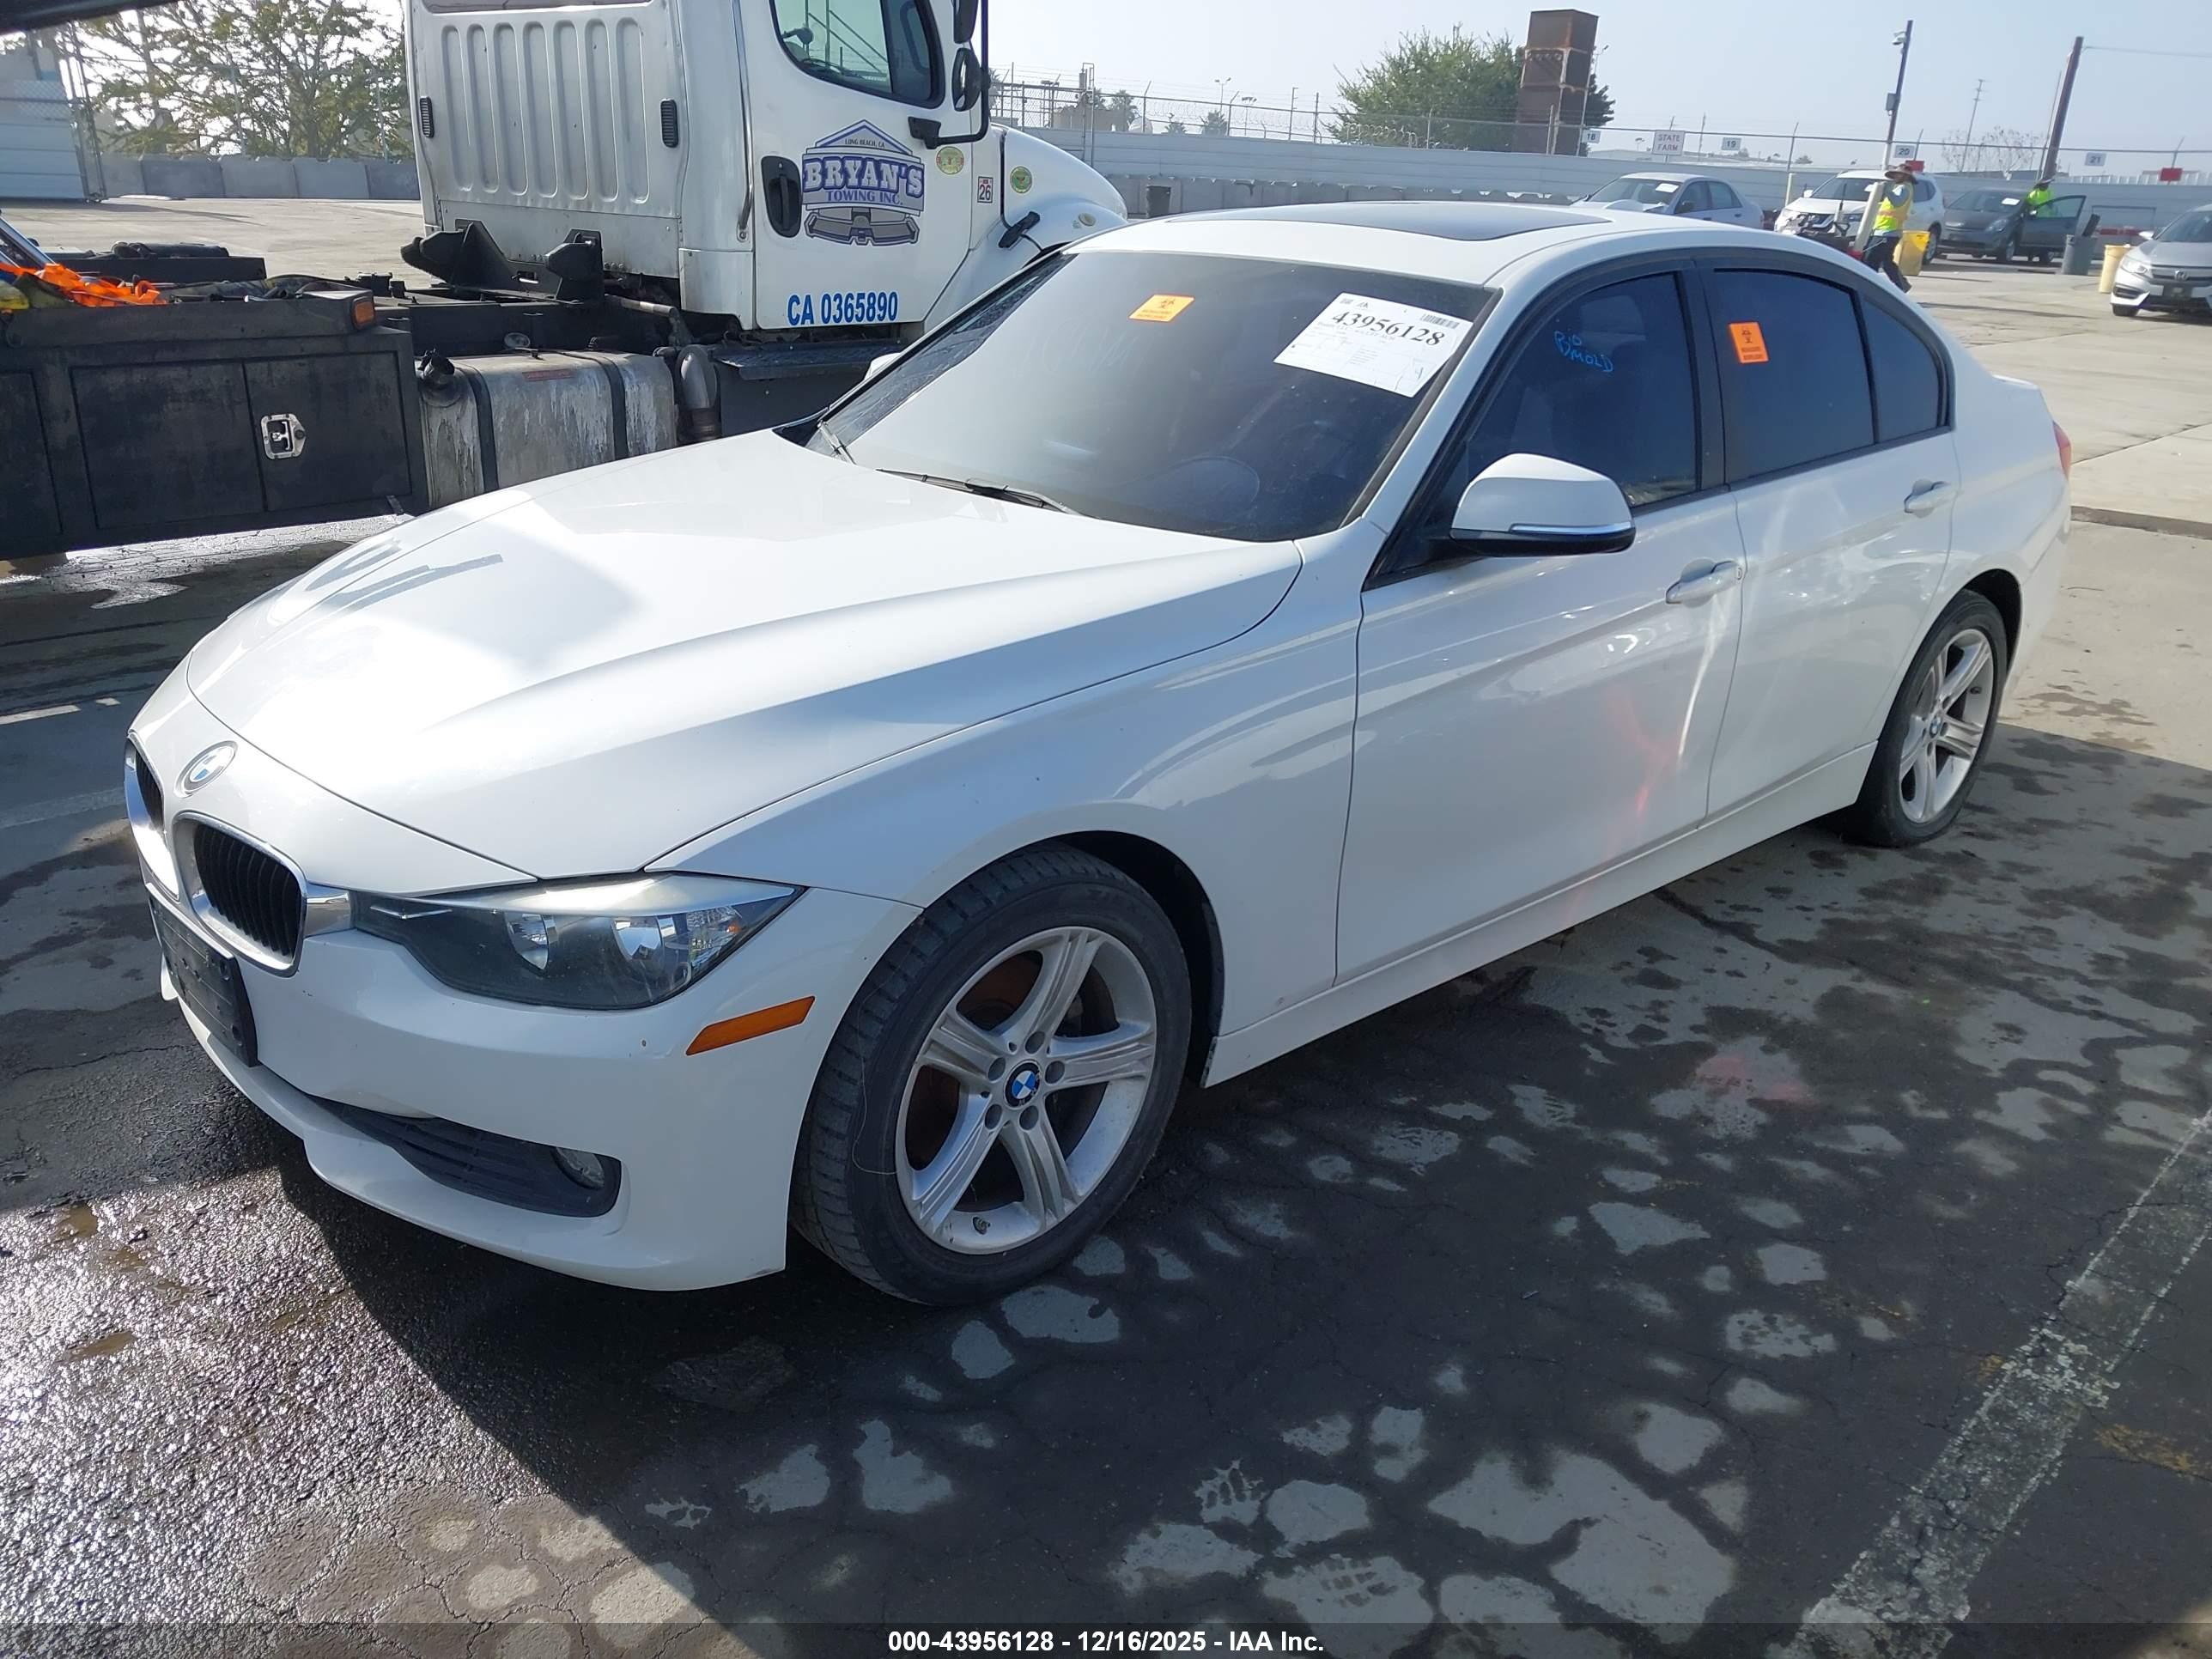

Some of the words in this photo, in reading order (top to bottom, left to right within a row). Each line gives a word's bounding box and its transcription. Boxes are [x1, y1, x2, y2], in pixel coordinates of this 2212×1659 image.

[1586, 132, 1596, 141] 18
[1657, 133, 1681, 142] STATE
[1657, 143, 1679, 152] FARM
[1726, 140, 1736, 149] 19
[1898, 148, 1910, 156] 20
[2089, 155, 2101, 164] 21
[804, 157, 923, 198] BRYAN'S
[827, 190, 876, 204] TOWING
[878, 191, 903, 205] INC.
[979, 185, 991, 201] 26
[787, 294, 815, 325] CA
[820, 291, 898, 323] 0365890
[1332, 310, 1446, 346] 43956128
